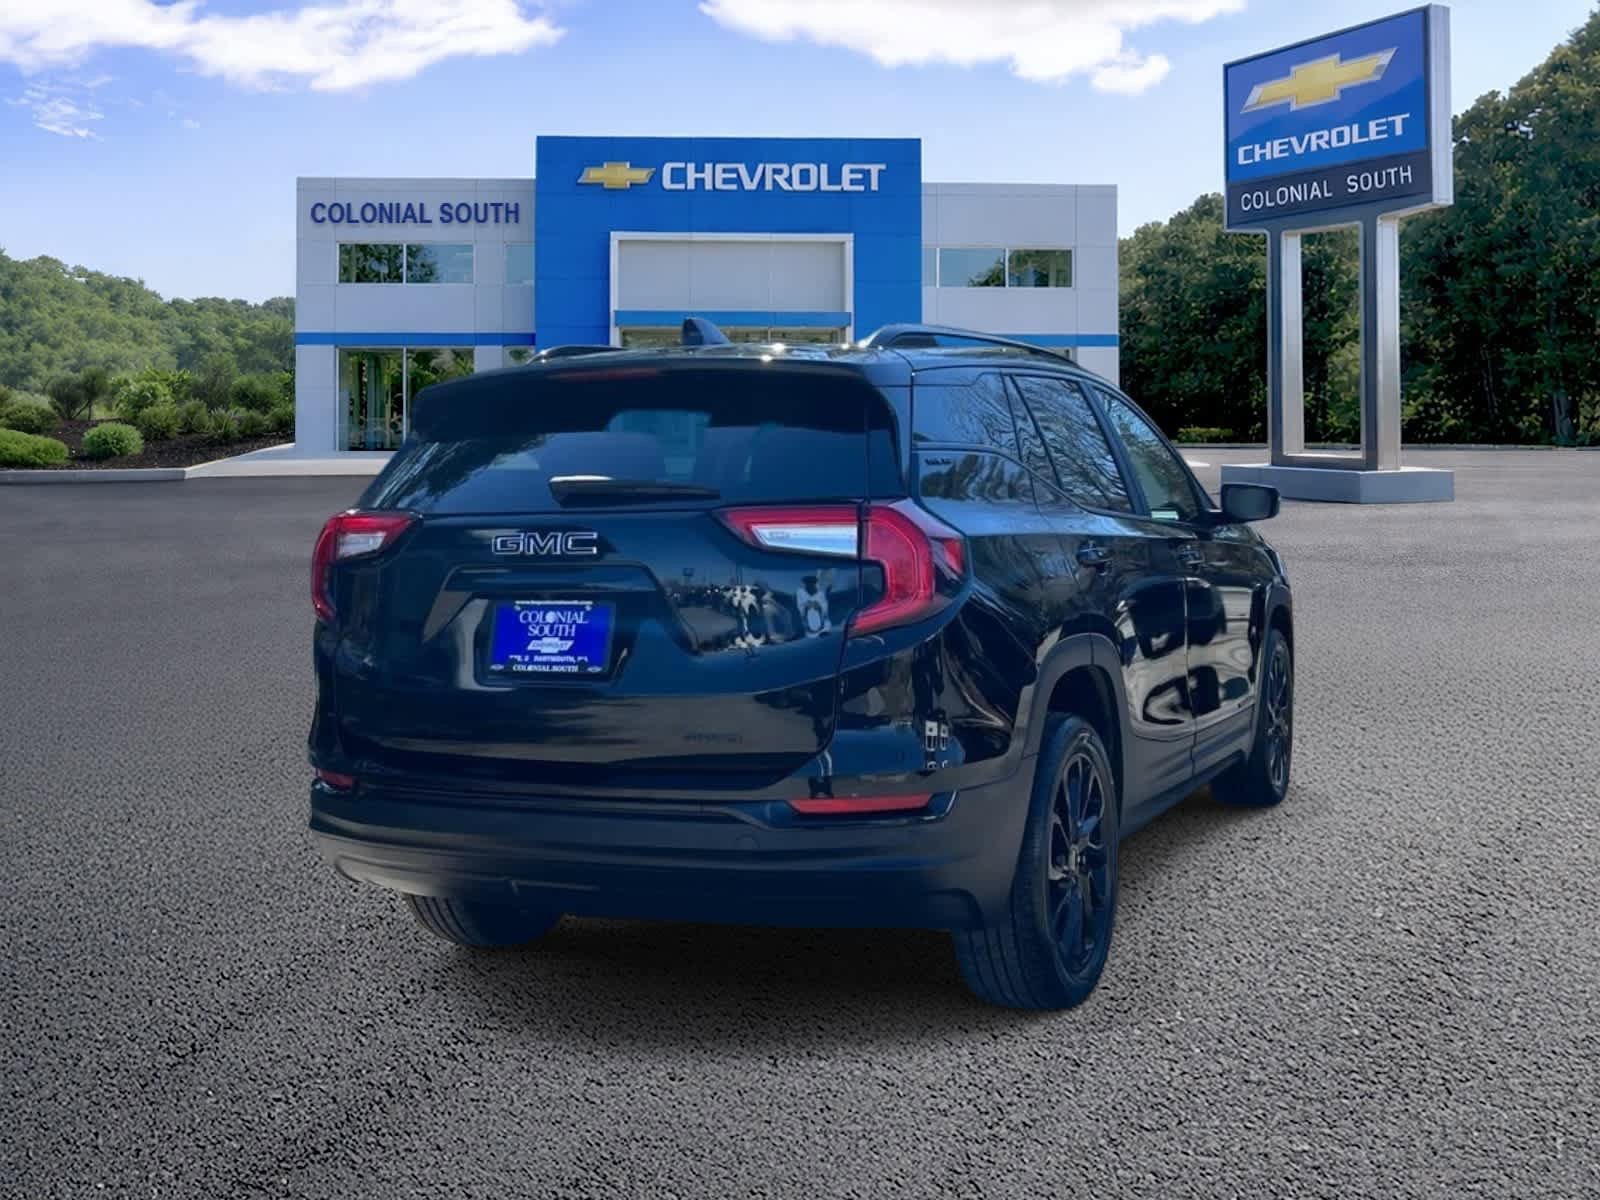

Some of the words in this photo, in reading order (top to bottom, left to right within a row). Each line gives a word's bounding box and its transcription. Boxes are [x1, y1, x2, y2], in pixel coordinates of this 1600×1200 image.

[1237, 113, 1410, 165] CHEVROLET
[662, 162, 886, 191] CHEVROLET
[1241, 180, 1333, 211] COLONIAL
[1346, 166, 1413, 193] SOUTH
[310, 202, 432, 224] COLONIAL
[439, 202, 520, 224] SOUTH
[491, 531, 598, 555] GMC
[519, 610, 589, 624] COLONIAL
[528, 624, 576, 637] SOUTH
